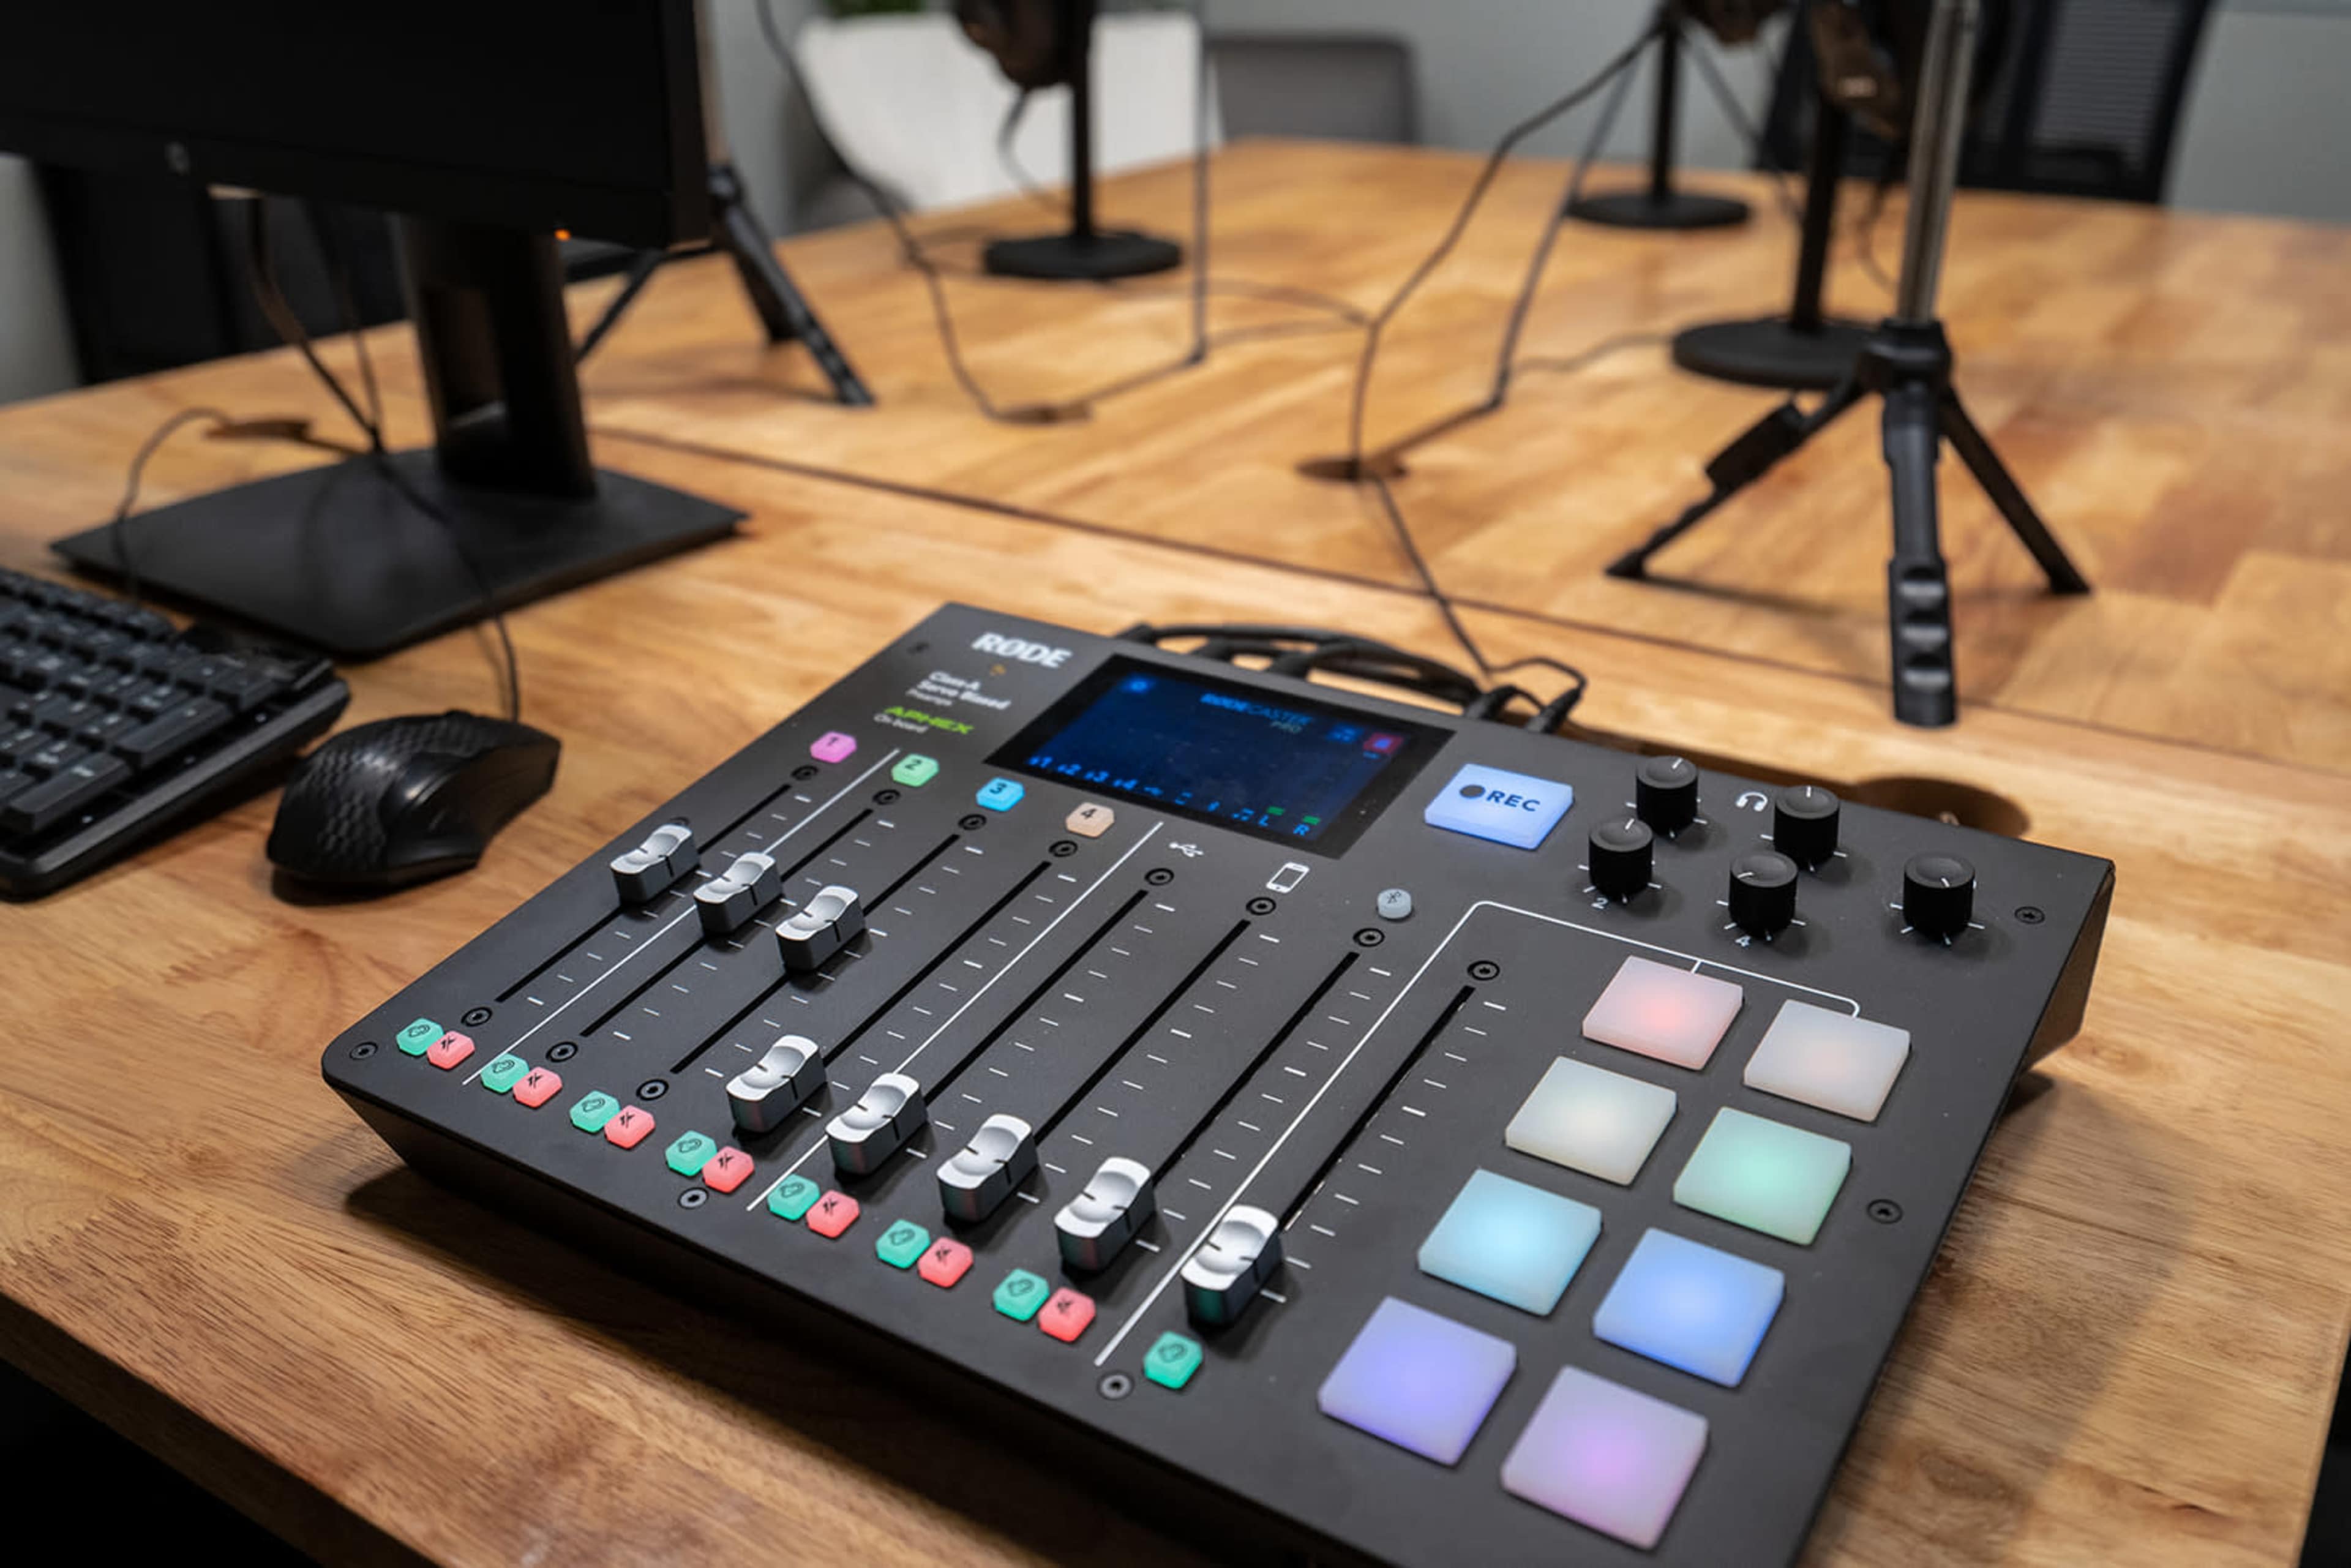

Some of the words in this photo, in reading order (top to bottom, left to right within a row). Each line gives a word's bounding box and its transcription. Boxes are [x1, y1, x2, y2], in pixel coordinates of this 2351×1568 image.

[885, 706, 974, 734] APHEX
[828, 737, 838, 746] 1
[904, 759, 921, 770] 2
[989, 782, 1007, 794] 3
[1486, 790, 1540, 812] REC
[1081, 808, 1097, 819] 4
[1292, 823, 1310, 836] R
[1592, 897, 1608, 909] 2
[1735, 935, 1752, 948] 4
